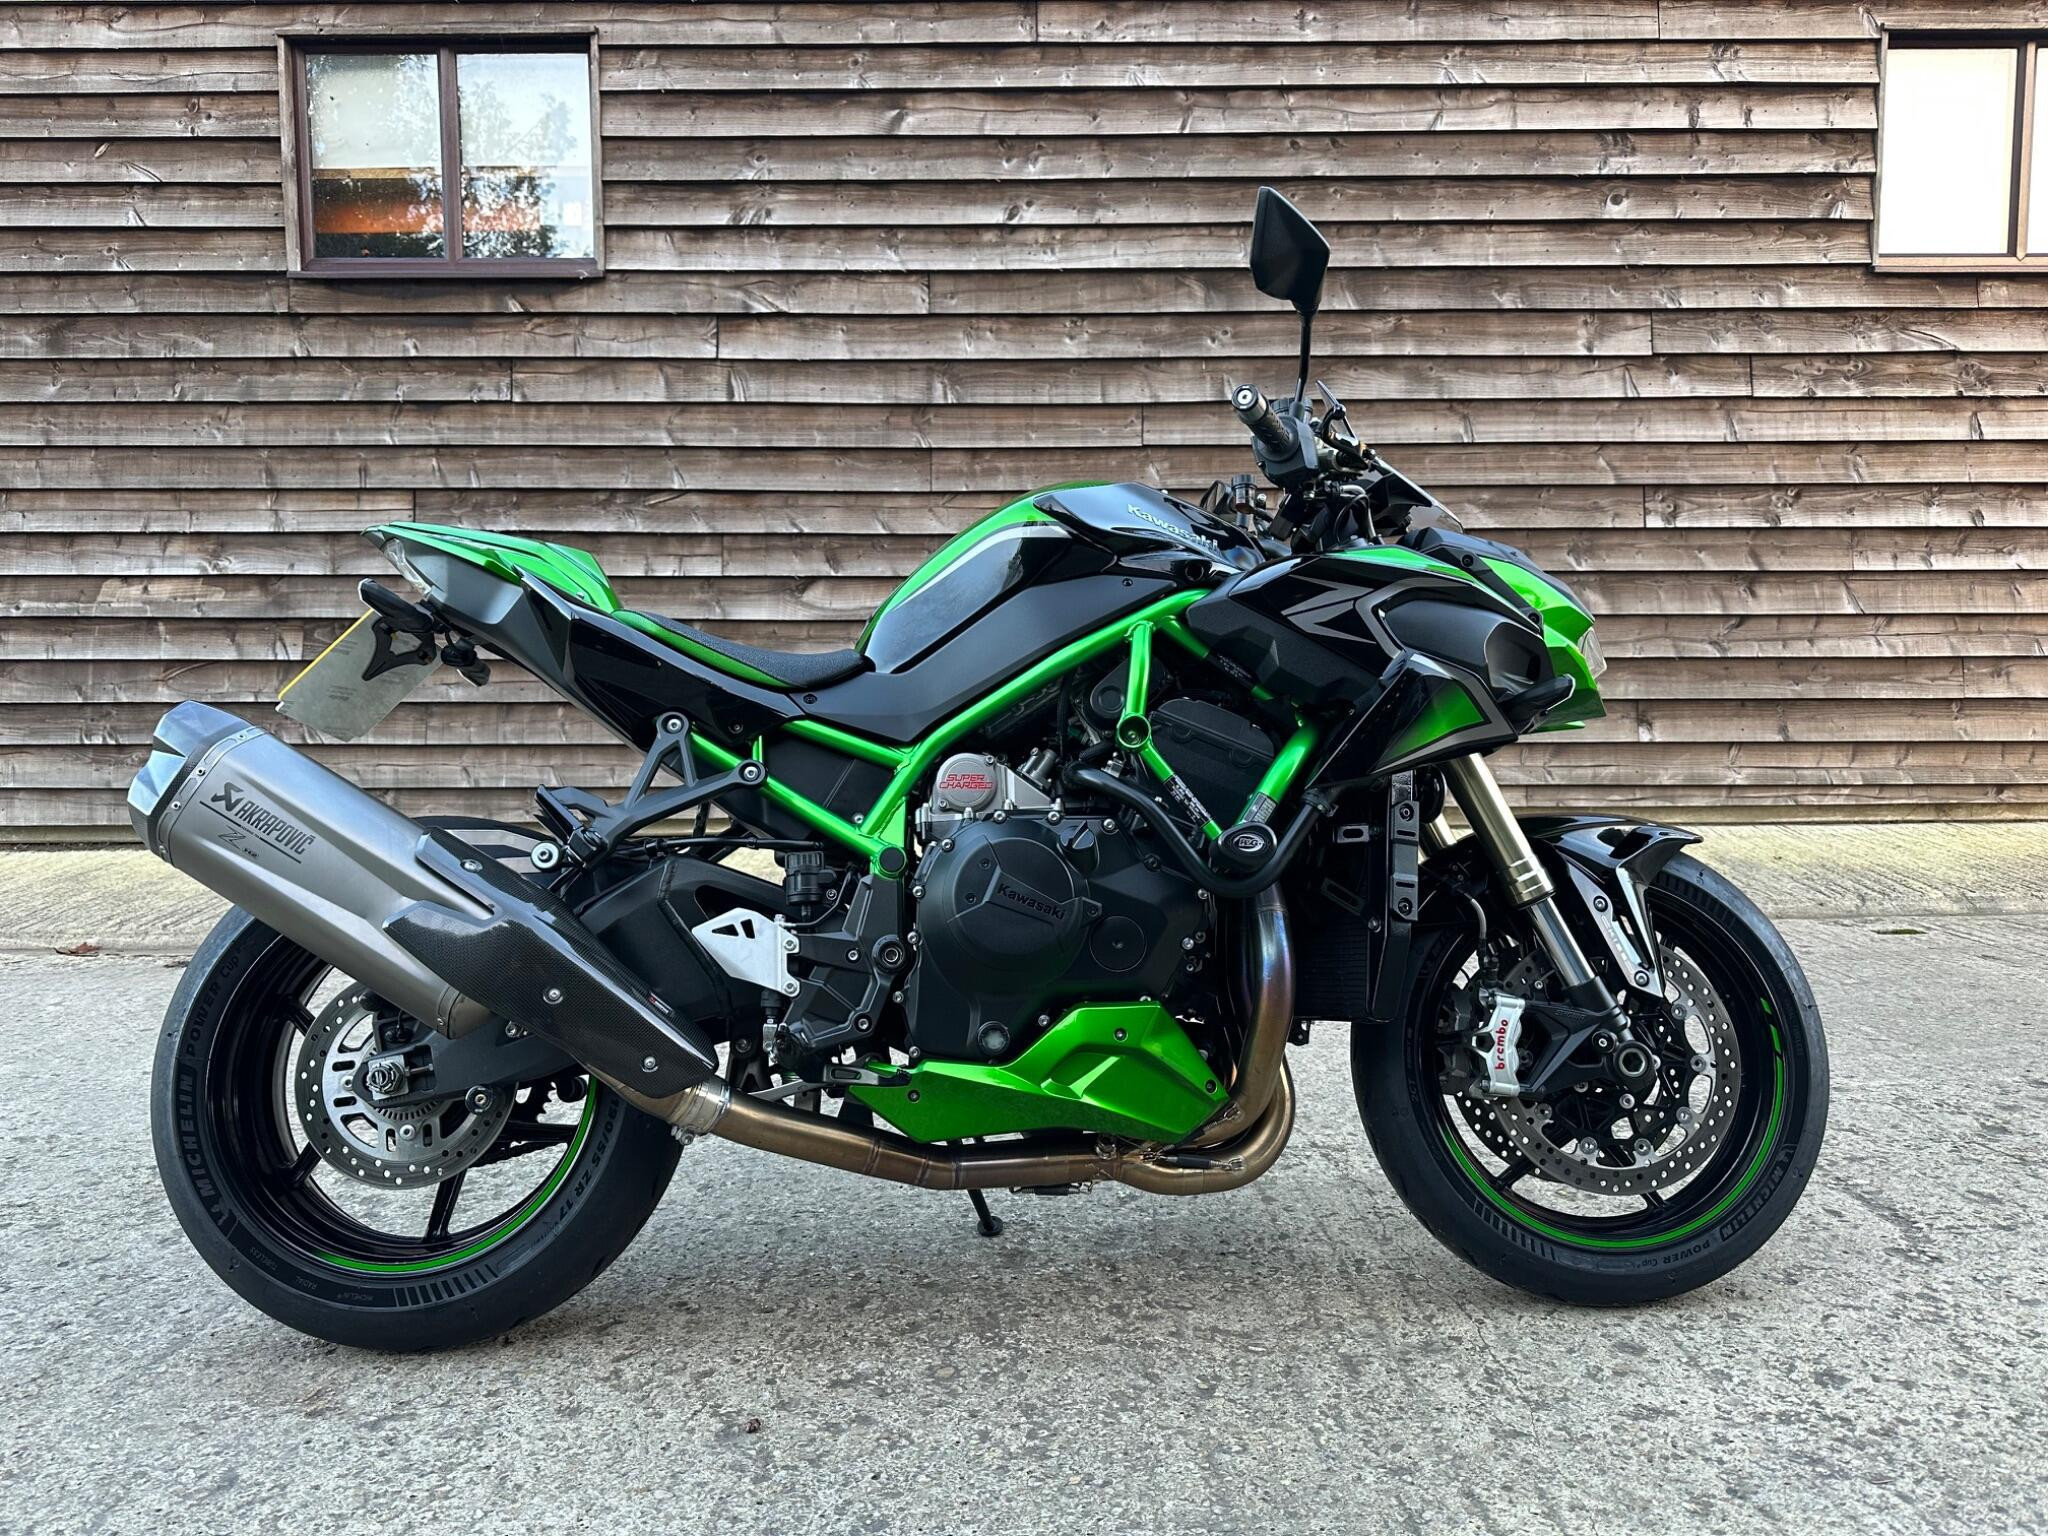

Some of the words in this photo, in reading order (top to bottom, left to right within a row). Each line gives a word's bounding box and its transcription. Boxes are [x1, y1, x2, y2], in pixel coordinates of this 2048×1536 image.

[1127, 503, 1220, 554] Kawasaki
[939, 781, 992, 789] CHARGED
[946, 773, 985, 782] SUPER
[996, 882, 1067, 921] Kawasaki
[185, 981, 221, 1057] POWER
[1494, 1019, 1509, 1070] brembo
[179, 1074, 216, 1199] MICHELIN
[591, 1098, 620, 1168] 190/55
[574, 1169, 592, 1198] ZR
[1721, 1165, 1785, 1238] MICHELIN
[559, 1198, 574, 1221] 17
[1663, 1239, 1711, 1265] POWER
